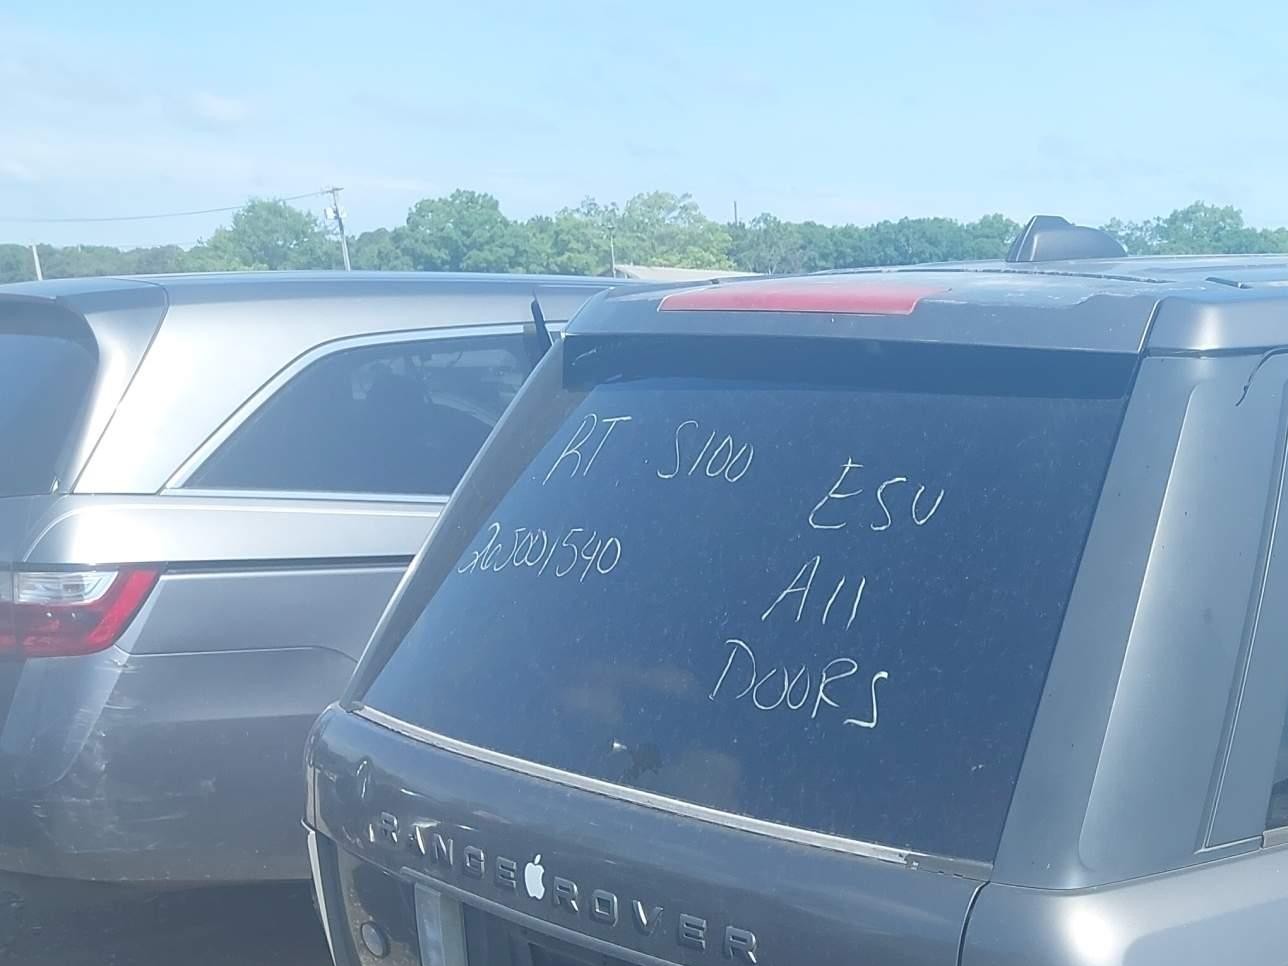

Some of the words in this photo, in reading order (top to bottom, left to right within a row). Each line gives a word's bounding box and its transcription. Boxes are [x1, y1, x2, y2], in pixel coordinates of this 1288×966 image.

[542, 413, 632, 486] RT
[657, 420, 754, 483] S100
[809, 457, 945, 530] ESU
[709, 639, 889, 728] DOORS
[379, 811, 518, 890] RANGE
[553, 875, 759, 965] ROVER
